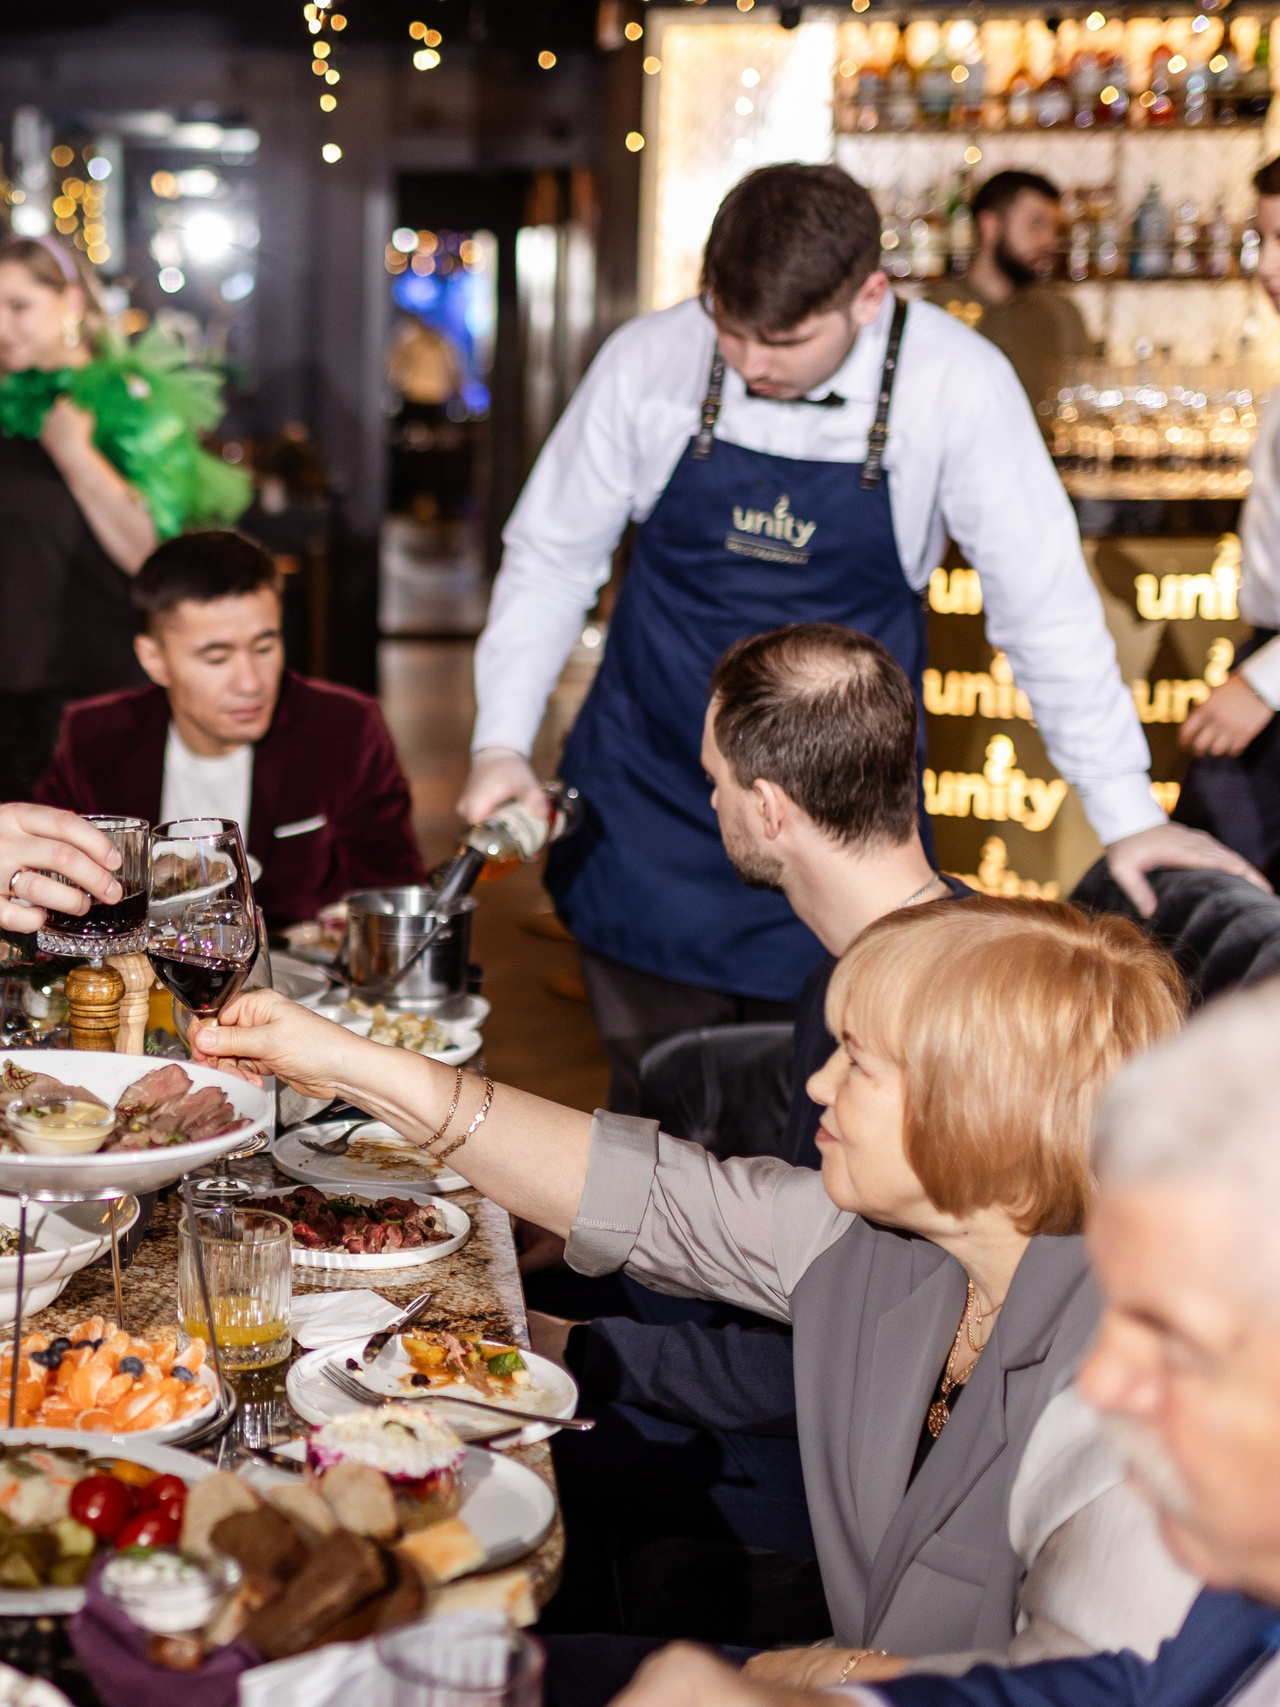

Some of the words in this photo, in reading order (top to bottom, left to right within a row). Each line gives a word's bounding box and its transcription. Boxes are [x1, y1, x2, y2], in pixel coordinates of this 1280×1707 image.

[732, 494, 817, 548] unity
[1135, 533, 1241, 620] uni
[923, 647, 1037, 728] uni
[923, 734, 1067, 832] unity
